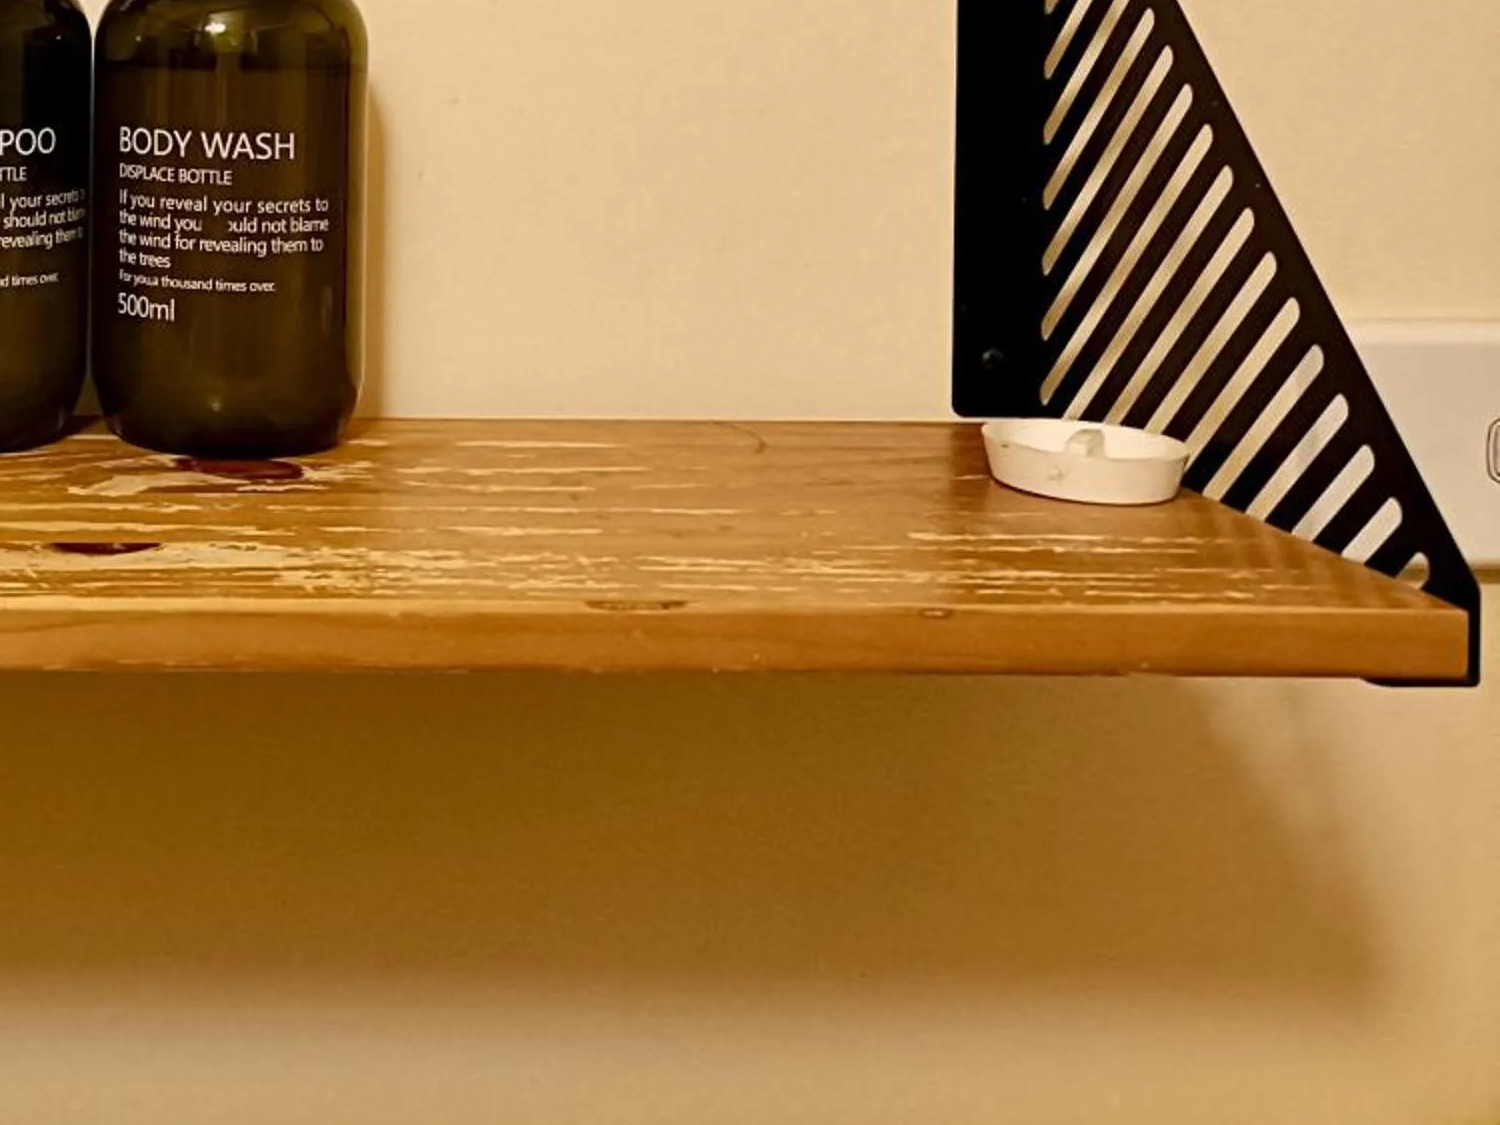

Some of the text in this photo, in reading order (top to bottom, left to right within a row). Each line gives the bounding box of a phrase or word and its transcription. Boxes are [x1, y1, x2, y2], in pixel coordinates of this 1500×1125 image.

[119, 126, 295, 160] BODY WASH
[119, 163, 233, 186] DISPLACE BOTTLE
[9, 195, 42, 213] your
[119, 188, 329, 217] If you reveal your secrets to
[3, 210, 47, 229] should
[48, 210, 66, 225] not
[119, 208, 137, 226] the
[139, 211, 171, 229] wind
[173, 218, 202, 233] you
[261, 218, 287, 234] not
[290, 216, 329, 233] blame
[119, 228, 325, 258] the wind for revealing them to
[119, 247, 171, 268] the trees
[11, 275, 38, 286] times
[161, 274, 213, 291] thousand
[215, 278, 247, 292] times
[117, 292, 175, 322] 500ml
